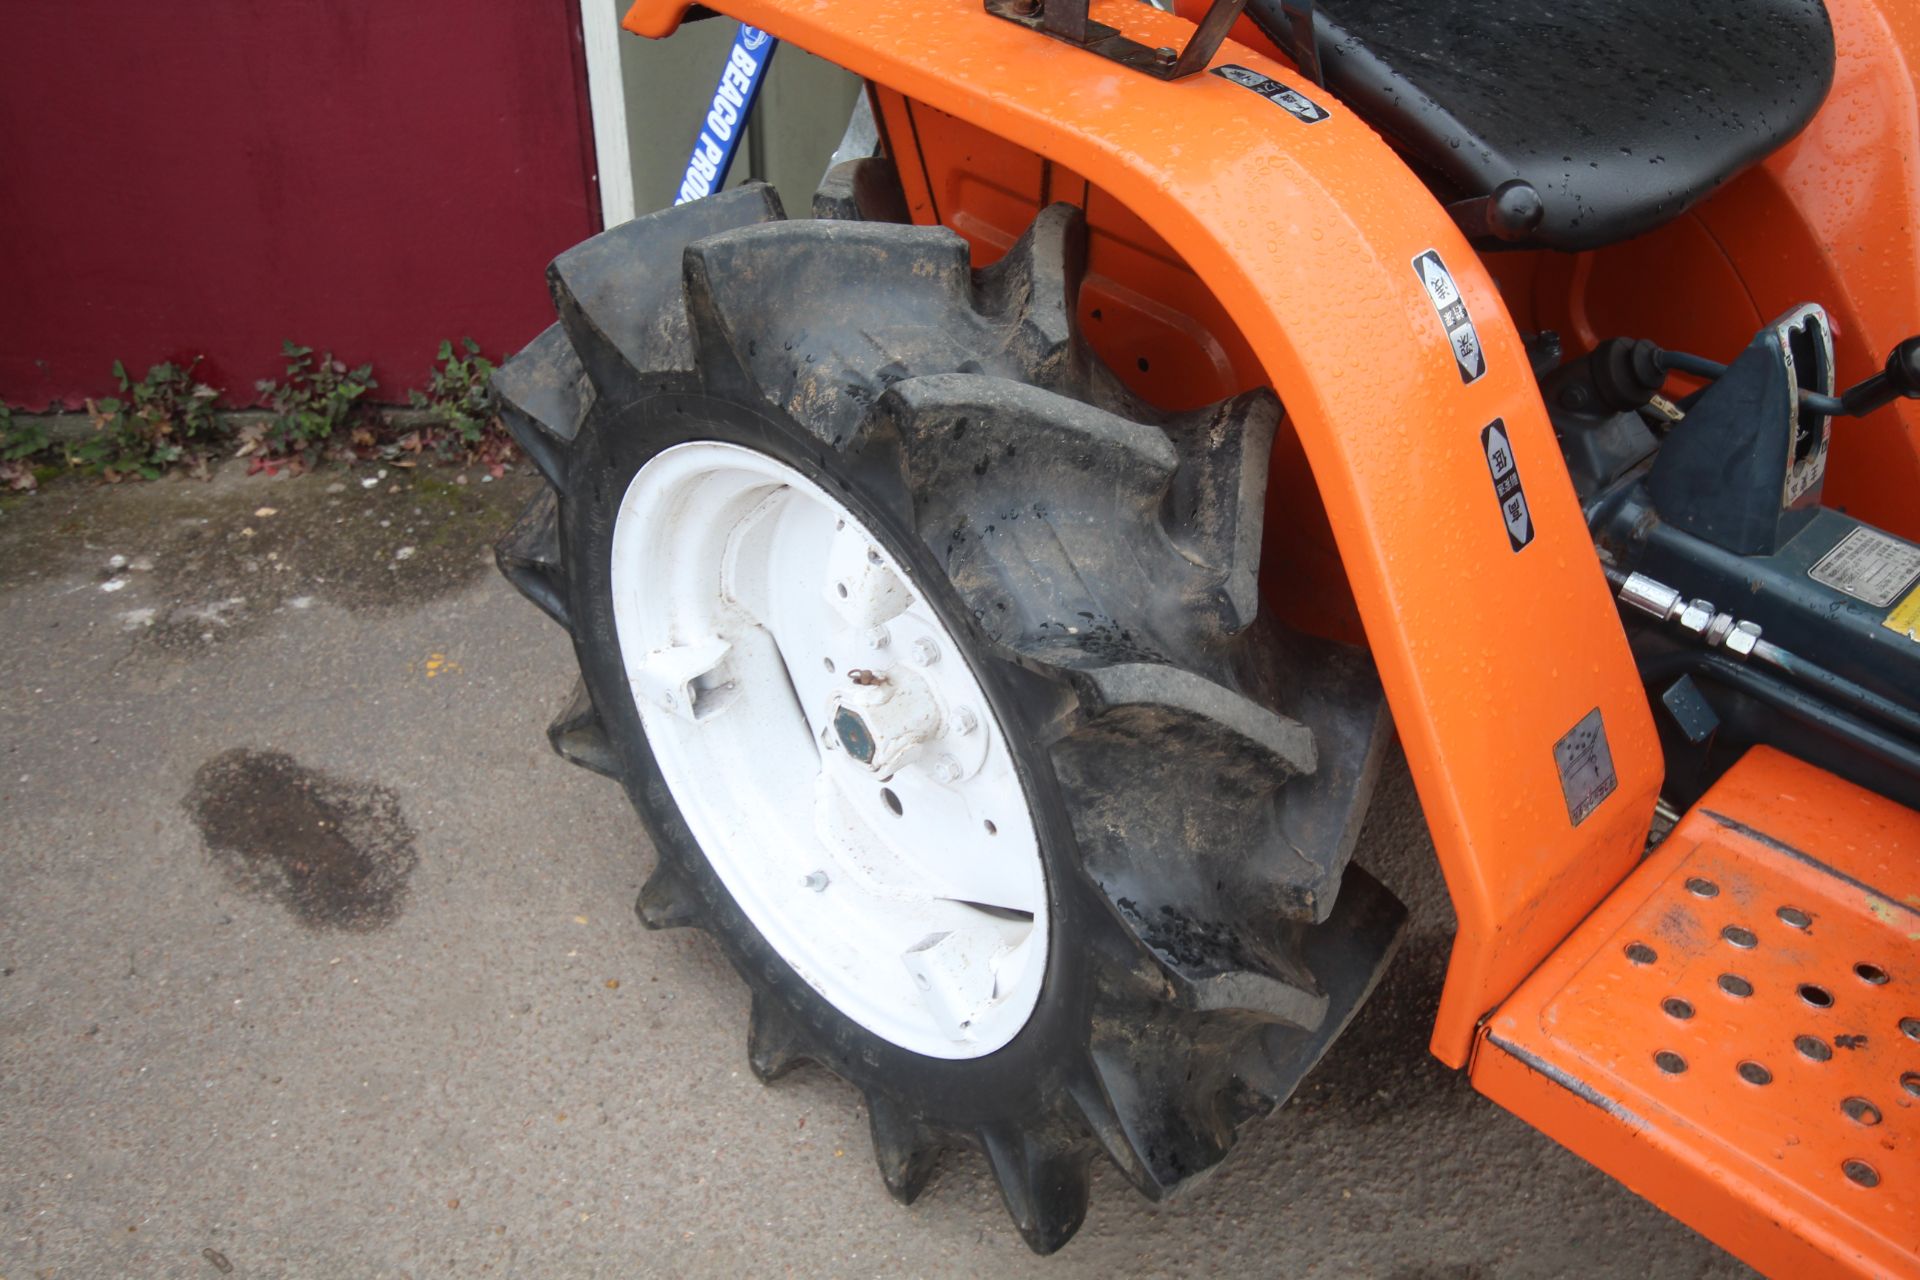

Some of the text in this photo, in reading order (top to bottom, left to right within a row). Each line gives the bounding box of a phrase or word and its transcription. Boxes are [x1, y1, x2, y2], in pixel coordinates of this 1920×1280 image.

[707, 43, 758, 142] BEACO
[1459, 332, 1474, 357] 深
[1492, 447, 1508, 473] 低
[1507, 498, 1523, 522] 高
